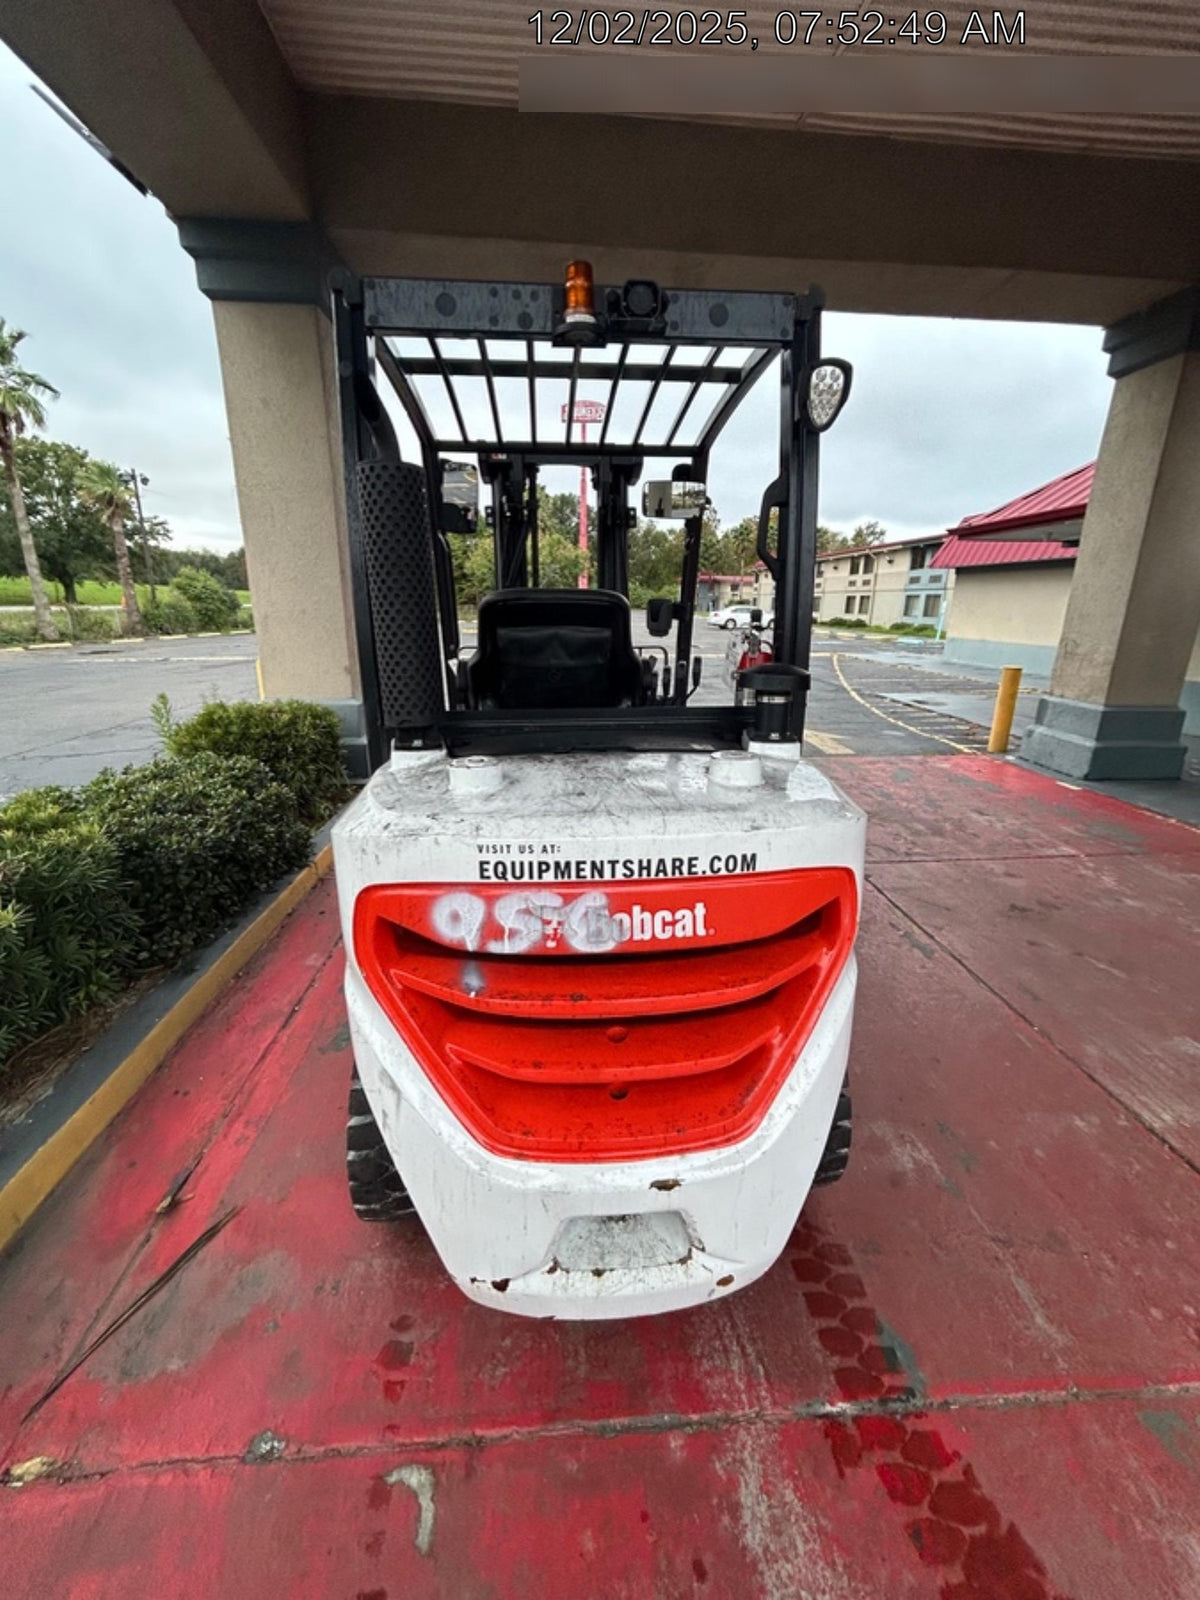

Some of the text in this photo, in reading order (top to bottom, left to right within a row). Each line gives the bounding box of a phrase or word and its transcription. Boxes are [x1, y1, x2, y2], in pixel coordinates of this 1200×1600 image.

[477, 844, 561, 854] VISIT US AT:
[478, 852, 757, 881] EQUIPMENTSHARE.COM
